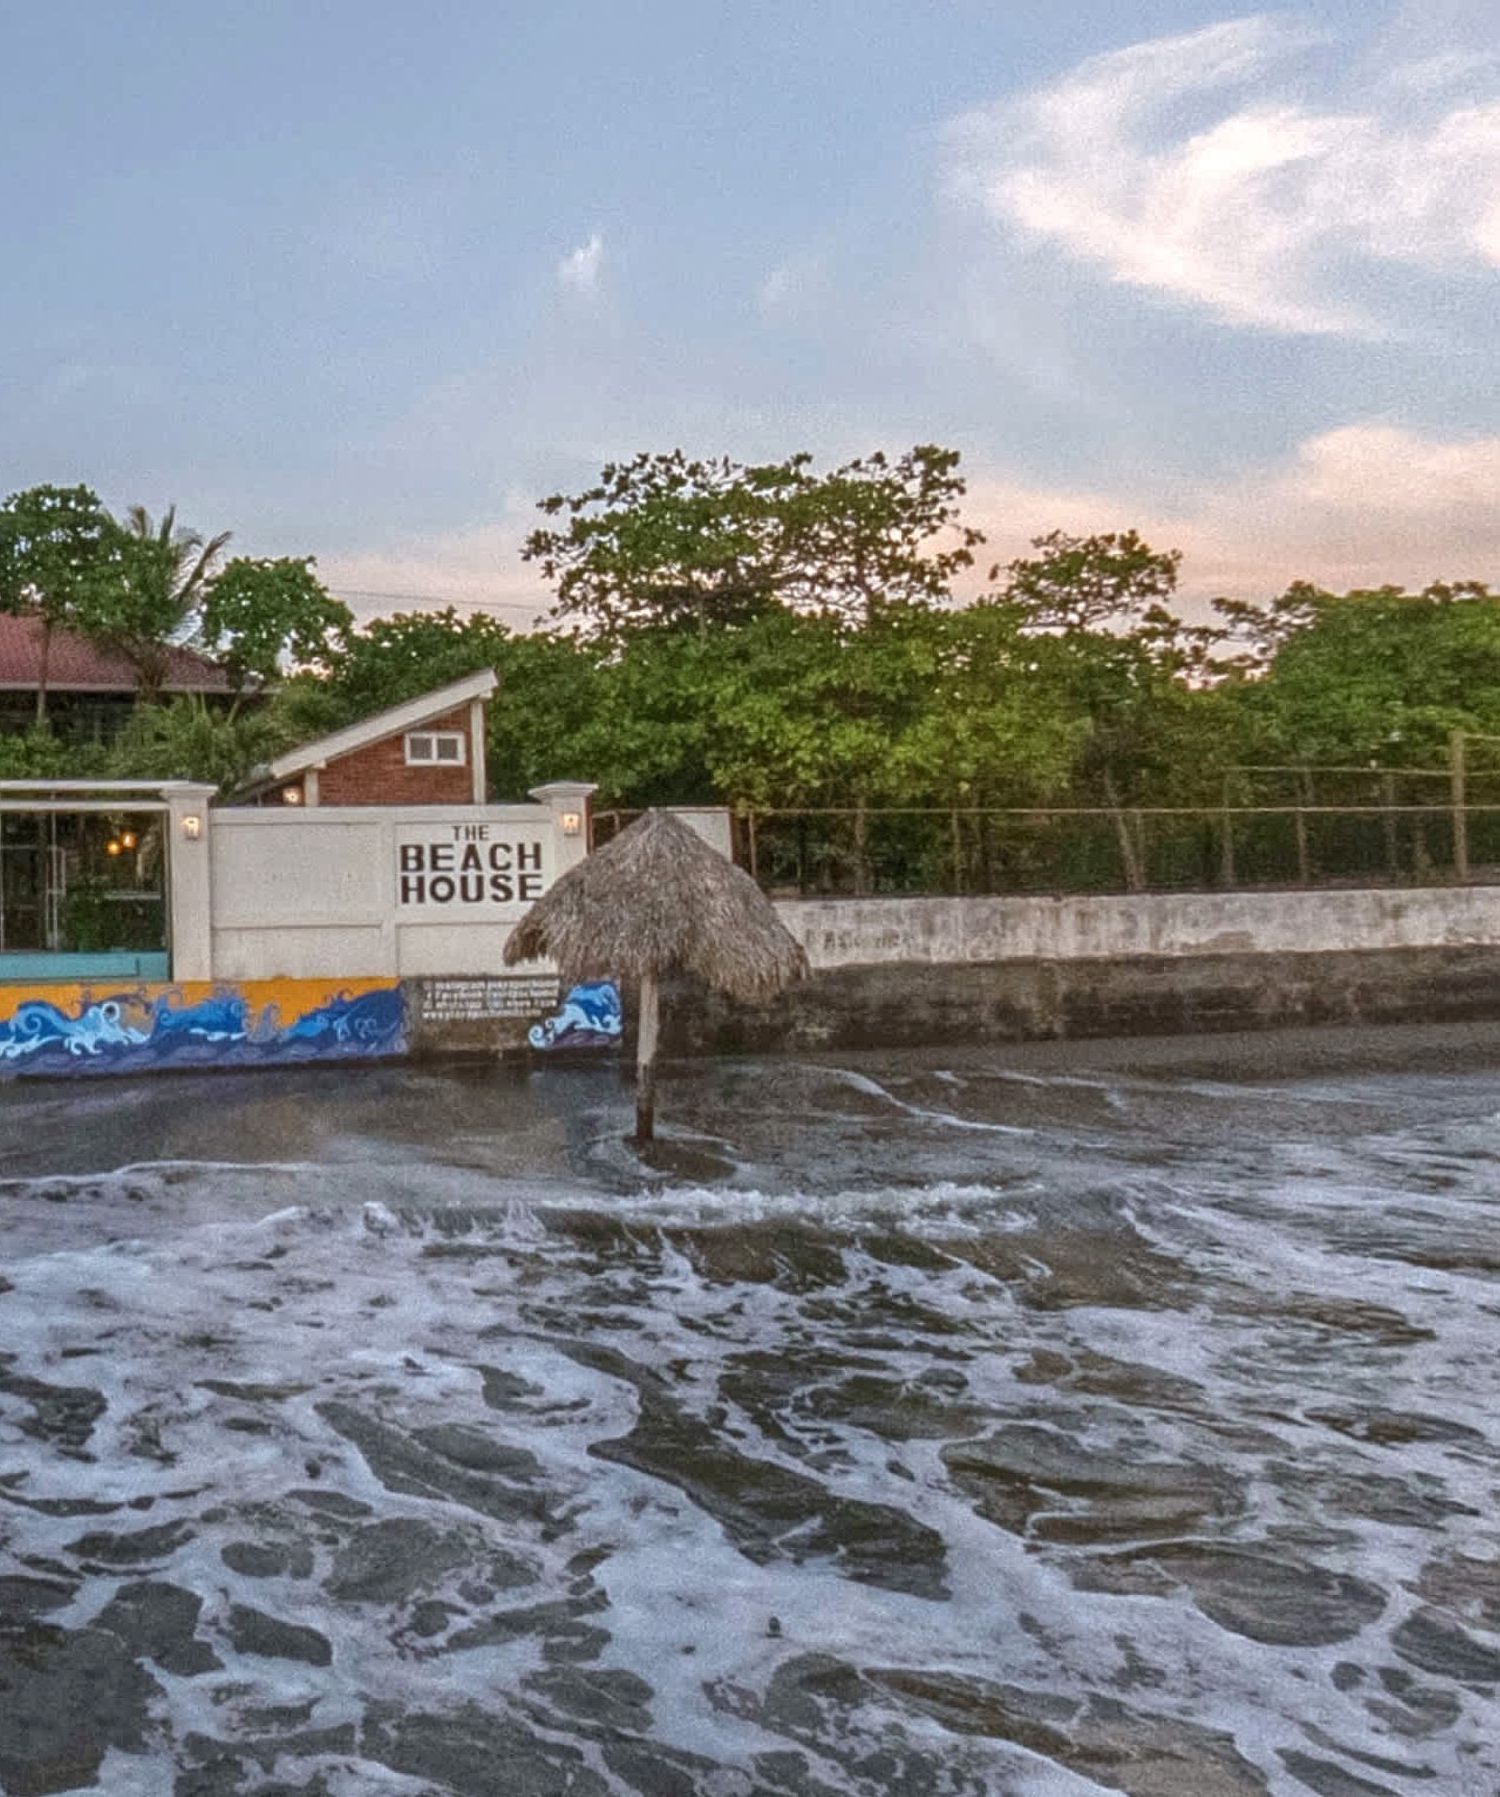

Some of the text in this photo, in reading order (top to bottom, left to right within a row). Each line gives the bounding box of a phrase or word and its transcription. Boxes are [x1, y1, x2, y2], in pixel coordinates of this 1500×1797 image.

[453, 825, 489, 841] THE
[401, 843, 542, 872] BEACH
[401, 874, 543, 904] HOUSE
